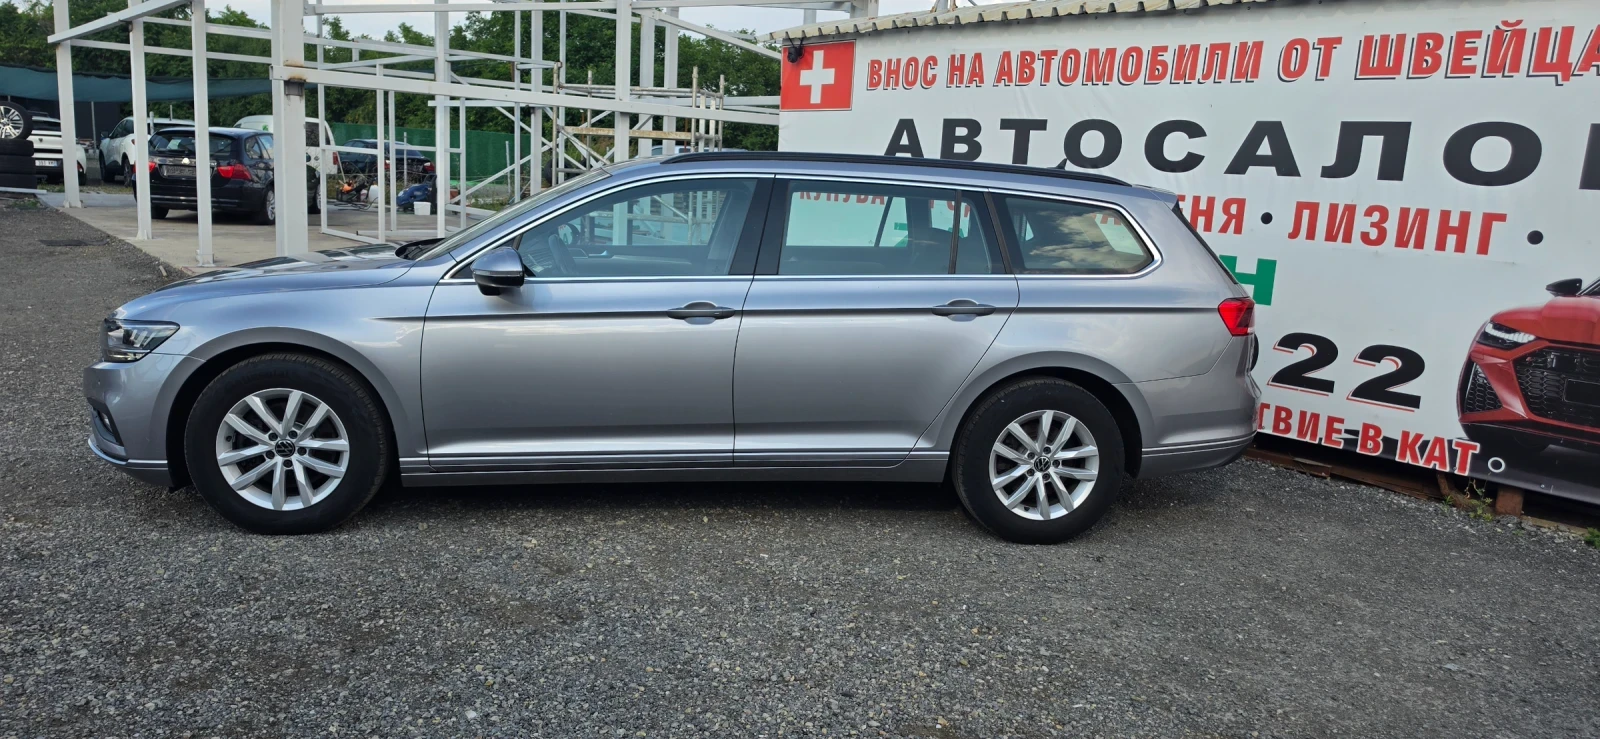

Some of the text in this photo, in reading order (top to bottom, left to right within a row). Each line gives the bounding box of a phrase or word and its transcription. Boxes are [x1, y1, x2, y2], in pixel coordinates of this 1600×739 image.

[867, 56, 938, 91] ВНОС
[946, 53, 985, 88] НА
[993, 41, 1264, 87] АВТОМОБИЛИ
[1278, 37, 1343, 82] ОТ
[1288, 201, 1507, 256] ЛИЗИНГ
[1251, 332, 1426, 412] 22
[1356, 421, 1384, 457] В
[1396, 431, 1481, 476] КАТ
